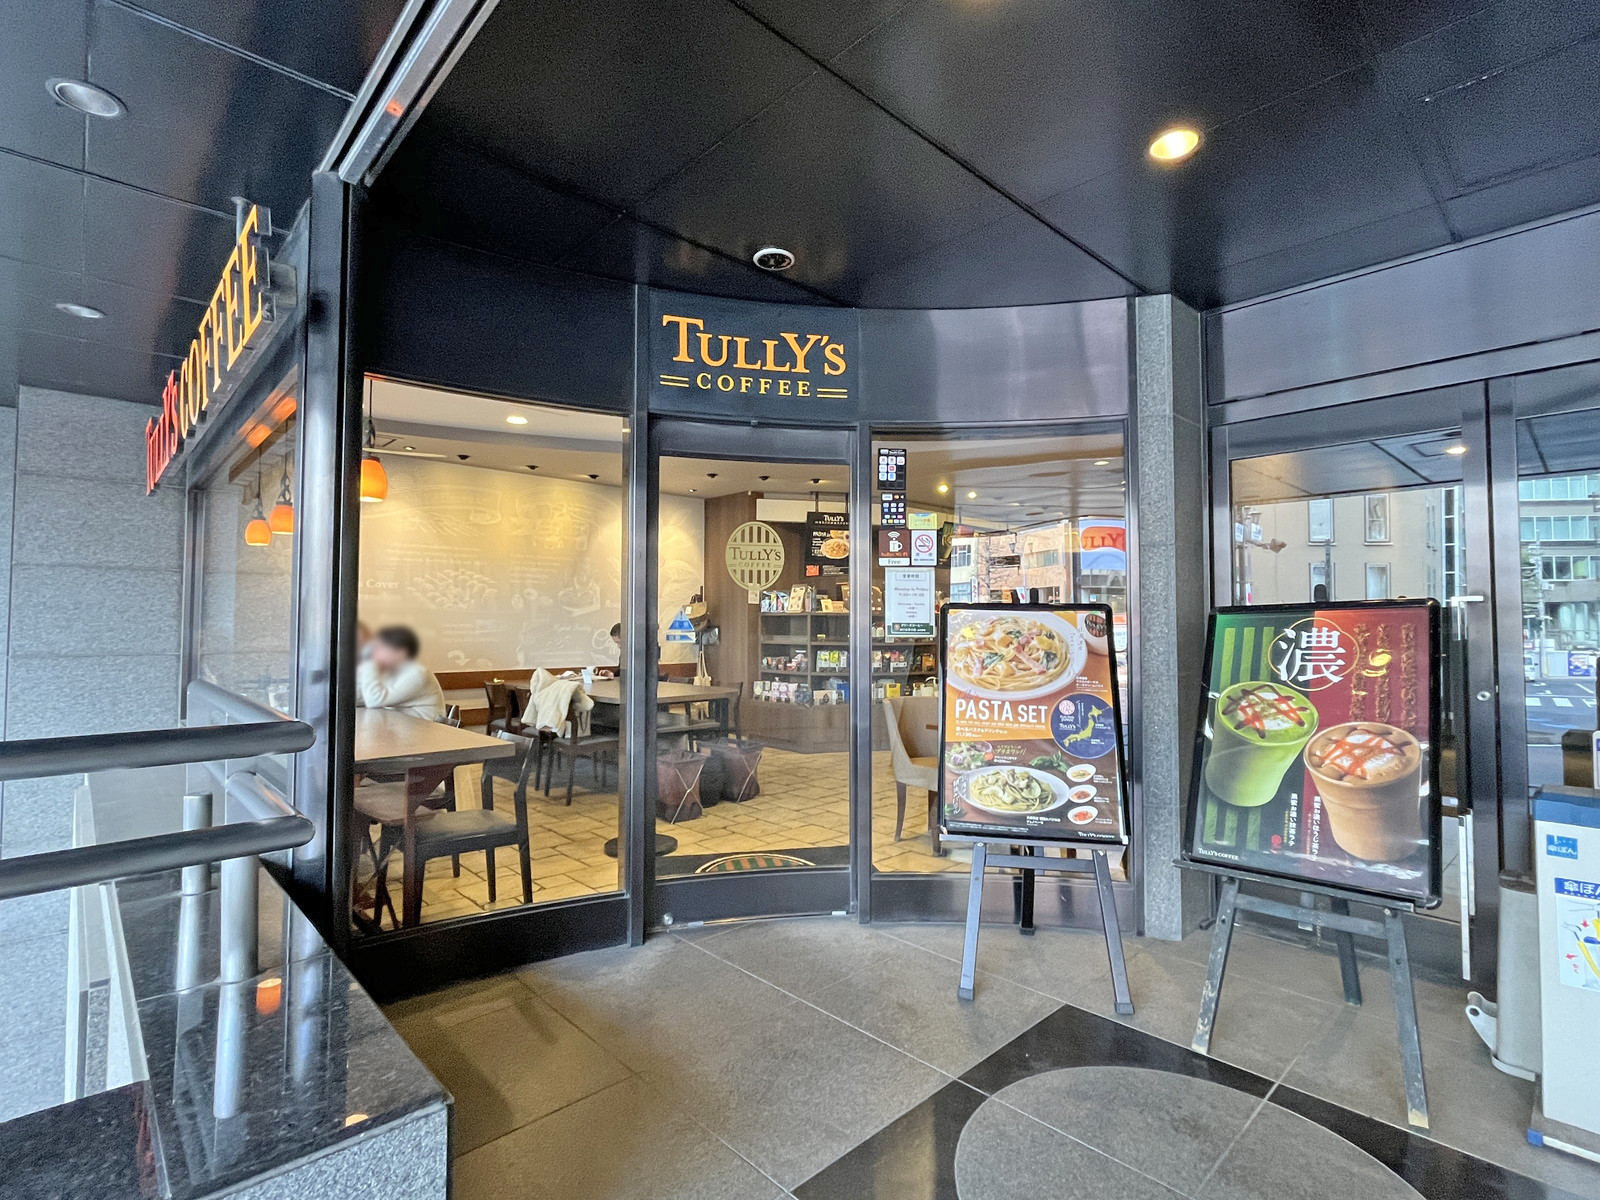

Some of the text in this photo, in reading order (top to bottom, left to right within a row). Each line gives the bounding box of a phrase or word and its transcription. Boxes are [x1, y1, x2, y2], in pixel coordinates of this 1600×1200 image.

[180, 204, 262, 440] COFFEE
[662, 314, 847, 376] TULLY'S
[696, 372, 811, 397] COFFEE
[729, 546, 782, 561] TULLY'S
[1277, 627, 1346, 684] 濃
[955, 698, 1048, 723] PASTA SET
